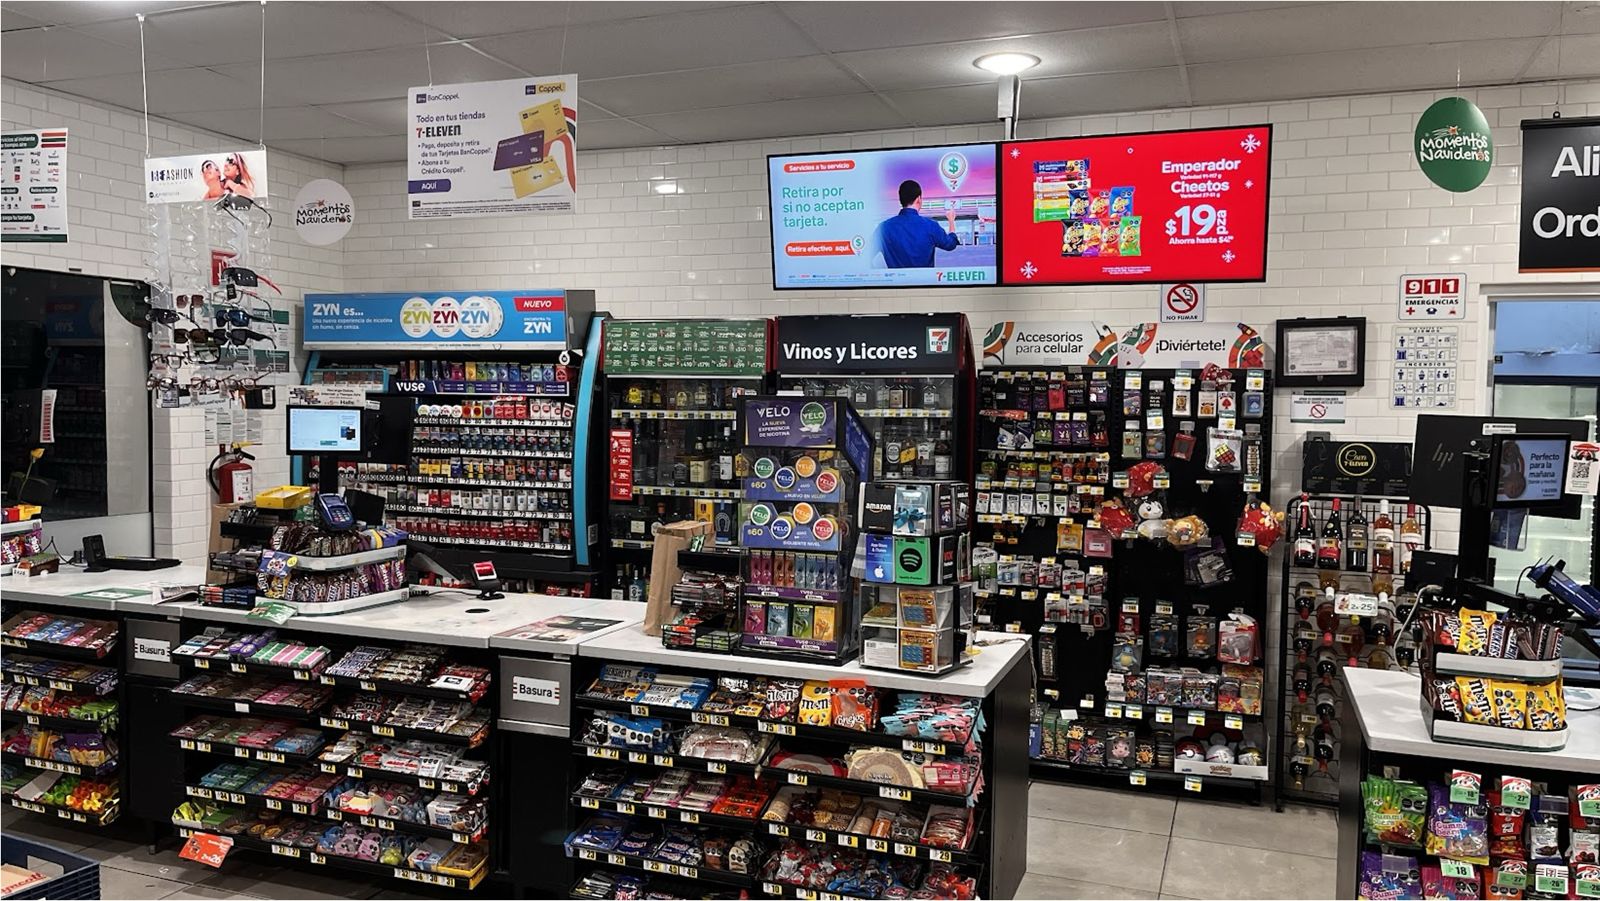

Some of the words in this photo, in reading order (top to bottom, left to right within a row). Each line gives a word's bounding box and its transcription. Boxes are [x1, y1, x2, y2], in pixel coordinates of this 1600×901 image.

[416, 114, 434, 124] Todo
[459, 111, 486, 121] tiendas
[438, 149, 459, 158] Tarjetas
[1162, 158, 1241, 175] Emperador
[422, 182, 437, 190] AQUÍ
[1171, 180, 1230, 193] Cheetos
[782, 185, 819, 199] Retira
[823, 186, 844, 200] por
[783, 202, 793, 213] si
[796, 204, 811, 213] no
[815, 200, 865, 213] aceptan
[784, 215, 828, 230] tarjeta.
[1217, 210, 1229, 235] pza
[1169, 237, 1195, 245] Ahorra
[787, 244, 807, 253] Retira
[808, 244, 833, 252] efectivo
[1408, 280, 1457, 294] 911
[313, 304, 340, 316] ZYN
[523, 300, 552, 309] NUEVO
[403, 310, 432, 324] ZYN
[461, 310, 490, 324] ZYN
[524, 322, 552, 334] ZYN
[1016, 331, 1083, 343] Accesorios
[1016, 344, 1041, 356] para
[1043, 343, 1084, 353] celular
[1156, 340, 1226, 354] ¡Diviértete!
[783, 343, 832, 360] Vinos
[832, 346, 847, 365] y
[851, 343, 918, 360] Licores
[802, 412, 825, 420] VELO
[1531, 453, 1560, 461] Perfecto
[1529, 470, 1555, 478] mañana
[866, 503, 892, 511] amazon
[140, 645, 166, 656] Basura
[520, 684, 553, 698] Basura
[637, 707, 646, 715] 35
[784, 726, 792, 735] 18
